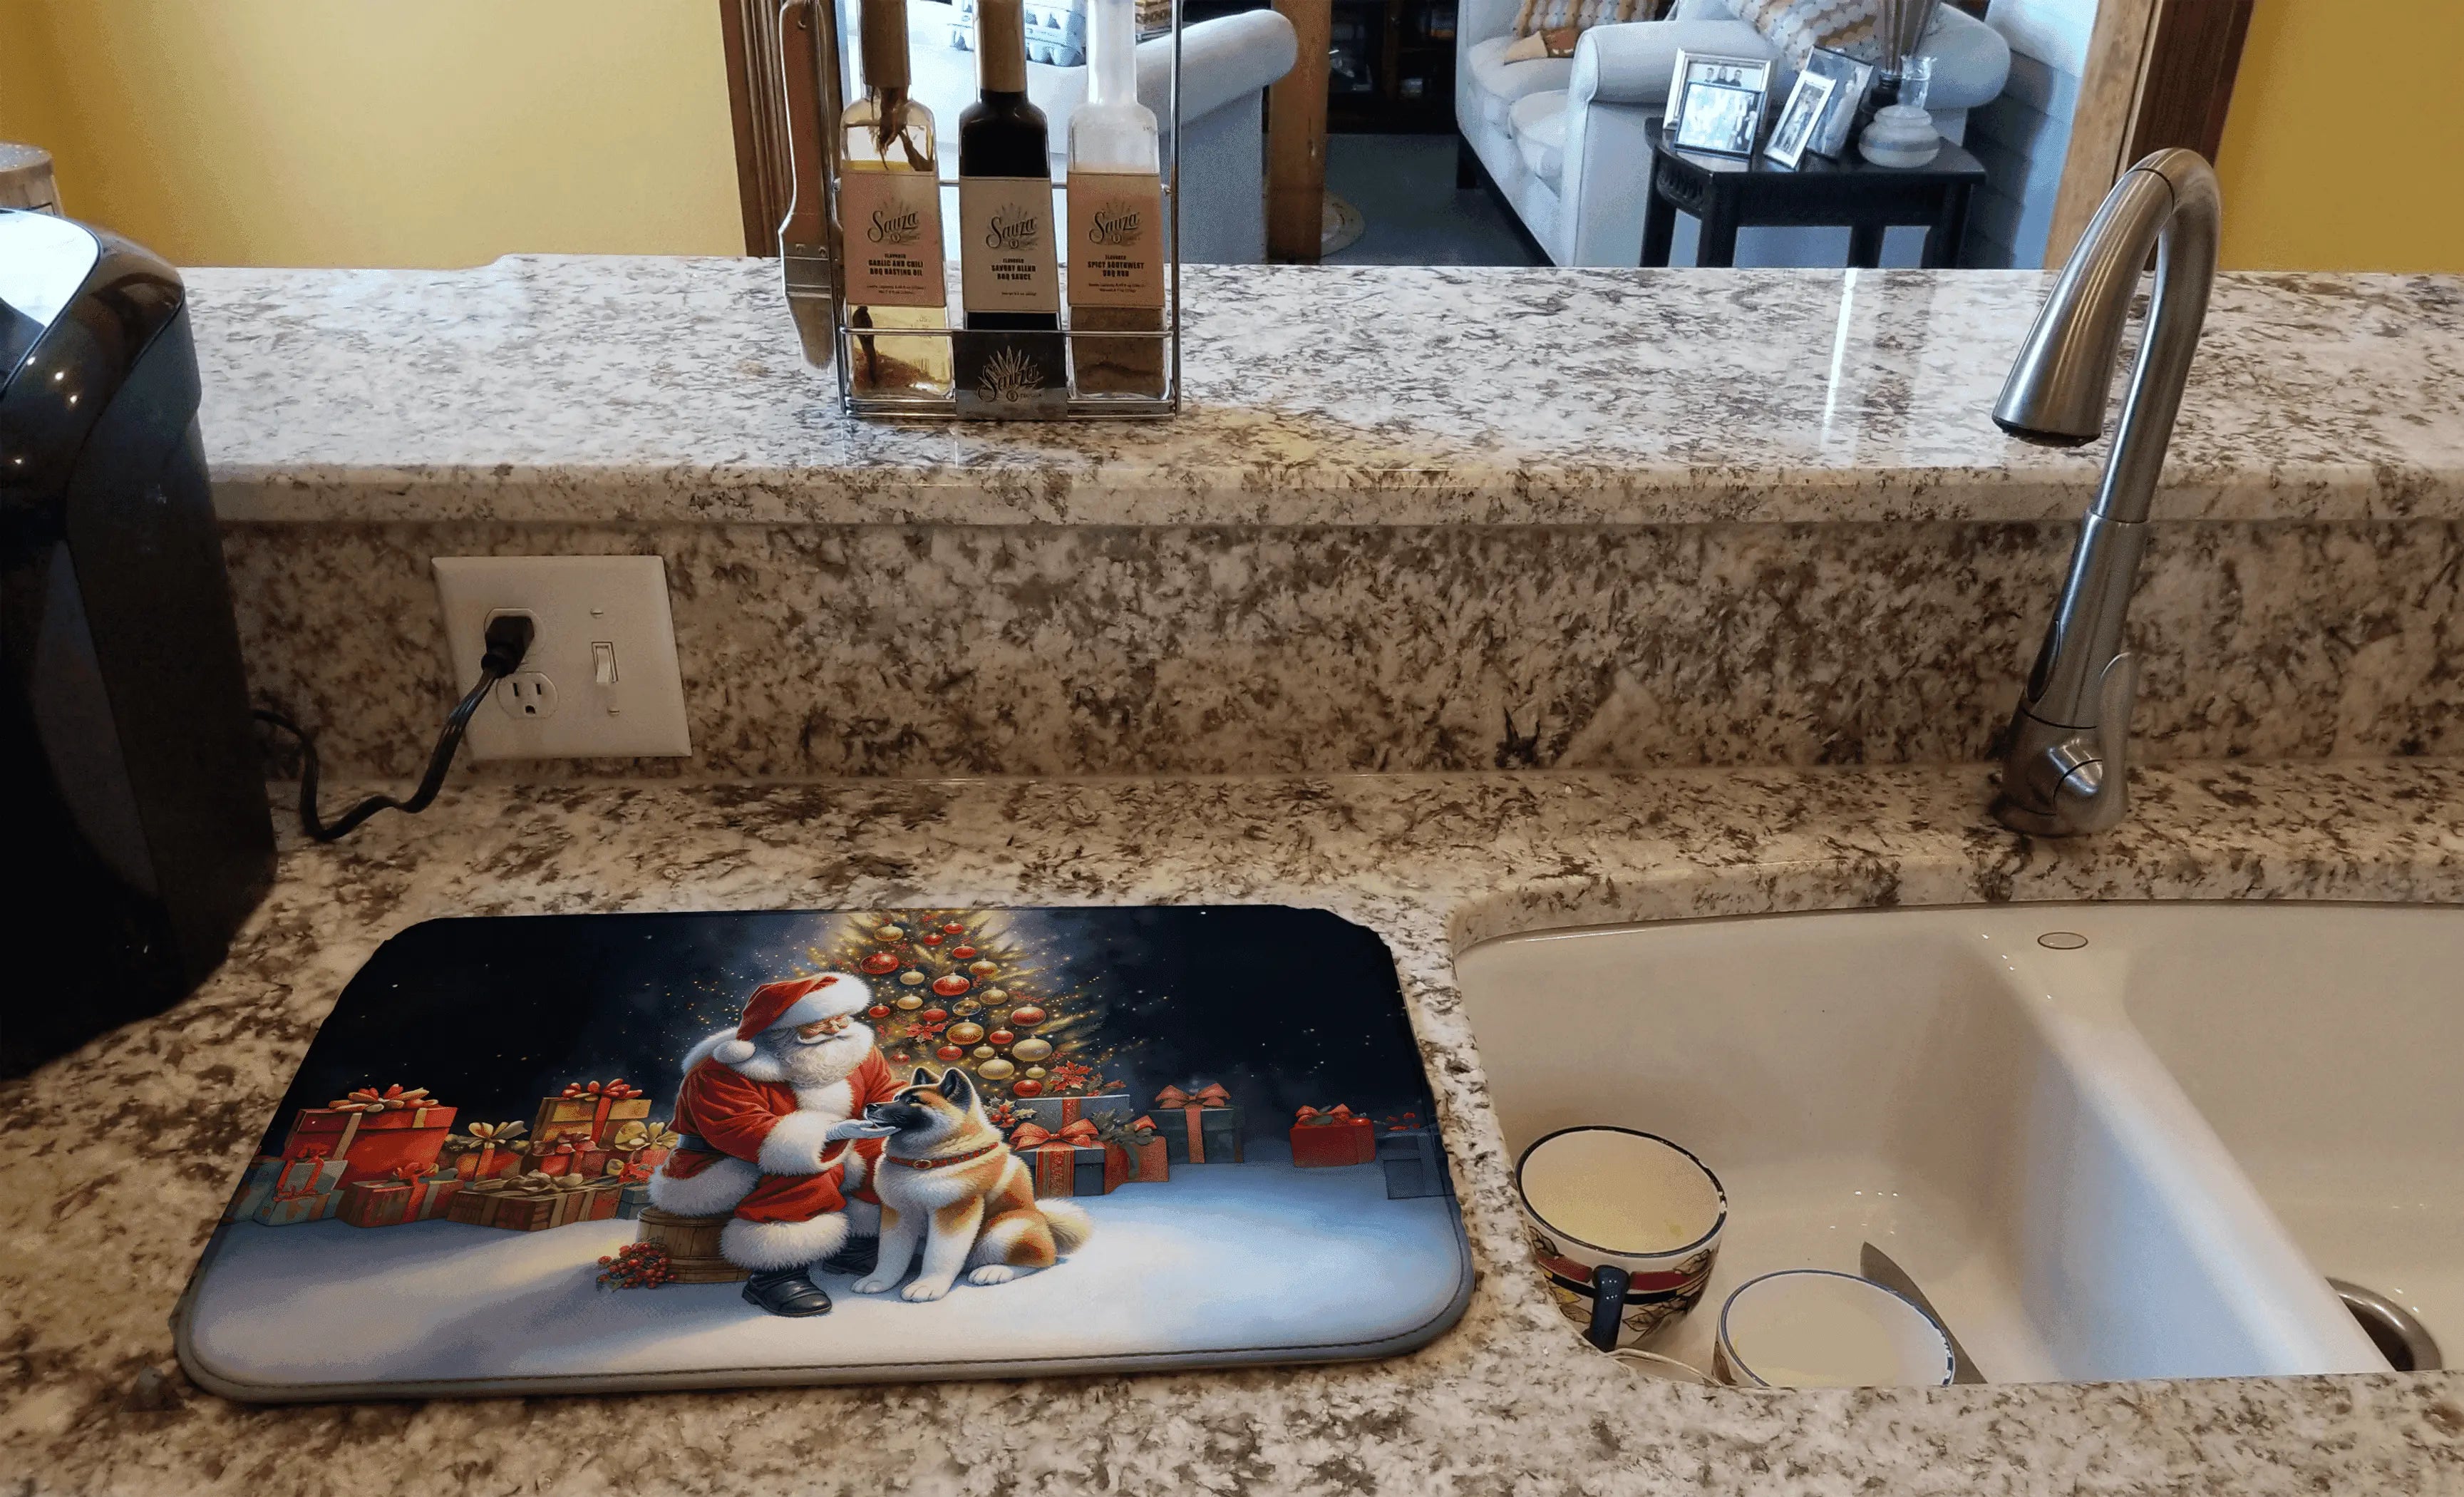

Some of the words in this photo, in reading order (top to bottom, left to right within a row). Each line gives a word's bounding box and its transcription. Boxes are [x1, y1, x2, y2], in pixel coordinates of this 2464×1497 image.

[867, 210, 919, 243] Sauza
[986, 216, 1036, 249] Sauza
[1088, 211, 1140, 245] Sauza
[977, 364, 1043, 402] Sauza
